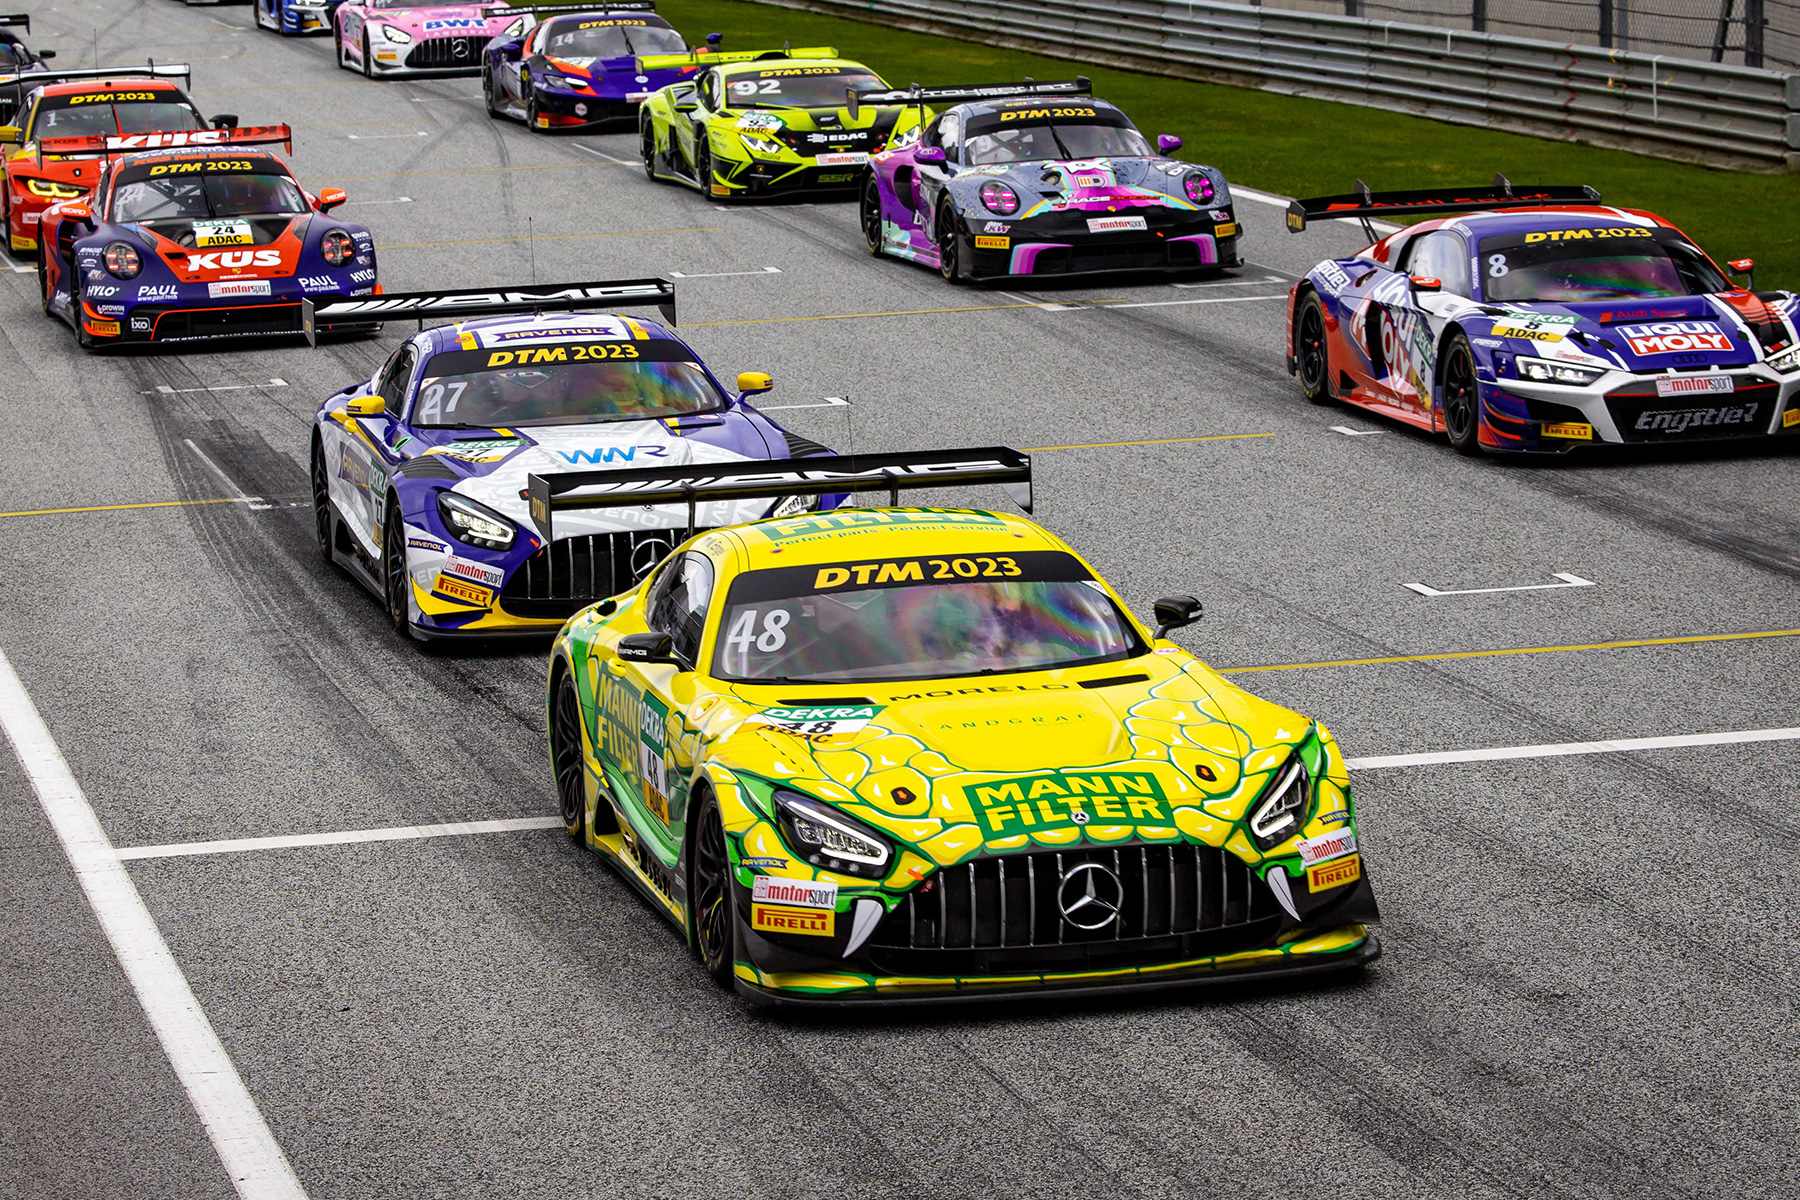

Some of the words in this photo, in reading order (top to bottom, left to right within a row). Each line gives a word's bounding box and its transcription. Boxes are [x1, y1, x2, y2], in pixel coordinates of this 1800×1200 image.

[425, 18, 488, 30] BWT
[579, 20, 614, 30] DTM
[616, 19, 646, 27] 2023
[555, 33, 574, 47] 14
[760, 69, 801, 78] DTM
[804, 67, 840, 75] 2023
[734, 79, 782, 96] 92
[69, 94, 114, 105] DTM
[116, 92, 155, 101] 2023
[1000, 108, 1050, 122] DTM
[1054, 108, 1096, 118] 2023
[106, 131, 221, 150] KÜS
[829, 132, 867, 141] EDAG
[149, 163, 202, 176] DTM
[207, 161, 253, 171] 2023
[192, 219, 248, 227] DEKRA
[1099, 218, 1146, 230] motorsport
[1286, 212, 1303, 229] DTM
[212, 226, 236, 235] 24
[1524, 229, 1594, 243] DTM
[1595, 227, 1653, 238] 2023
[207, 234, 242, 245] ADAC
[187, 250, 282, 272] KÜS
[1487, 253, 1509, 278] 8
[221, 284, 270, 294] motorsport
[298, 275, 338, 288] PAUL
[138, 285, 179, 297] PAUL
[1510, 313, 1575, 325] DEKRA
[1616, 309, 1648, 318] Audi
[504, 327, 604, 339] RAVENOL
[1503, 327, 1550, 341] ADAC
[1622, 321, 1715, 338] LIQUI
[1633, 334, 1724, 354] MOLY
[486, 347, 567, 367] DTM
[570, 344, 640, 361] 2023
[1671, 376, 1733, 392] motorsport
[420, 381, 468, 416] 27
[1544, 423, 1588, 437] PIRELLI
[449, 440, 522, 450] DEKRA
[532, 496, 547, 523] DTM
[770, 511, 992, 537] FILTER
[409, 540, 445, 551] RAVENOL
[774, 533, 833, 548] Perfect
[455, 562, 501, 585] motorsport
[813, 562, 925, 590] DTM
[928, 557, 1022, 579] 2023
[438, 577, 489, 603] PIRELLI
[728, 608, 791, 654] 48
[890, 684, 1070, 702] MORELO
[763, 707, 874, 719] DEKRA
[640, 701, 665, 748] DEKRA
[778, 721, 837, 734] 48
[757, 724, 834, 744] ADAC
[975, 775, 1154, 807] MANN
[984, 795, 1166, 832] FILTER
[741, 859, 783, 867] RAVENOL
[1312, 858, 1358, 887] PIRELLI
[768, 884, 836, 906] motorsport
[757, 907, 828, 931] PIRELLI
